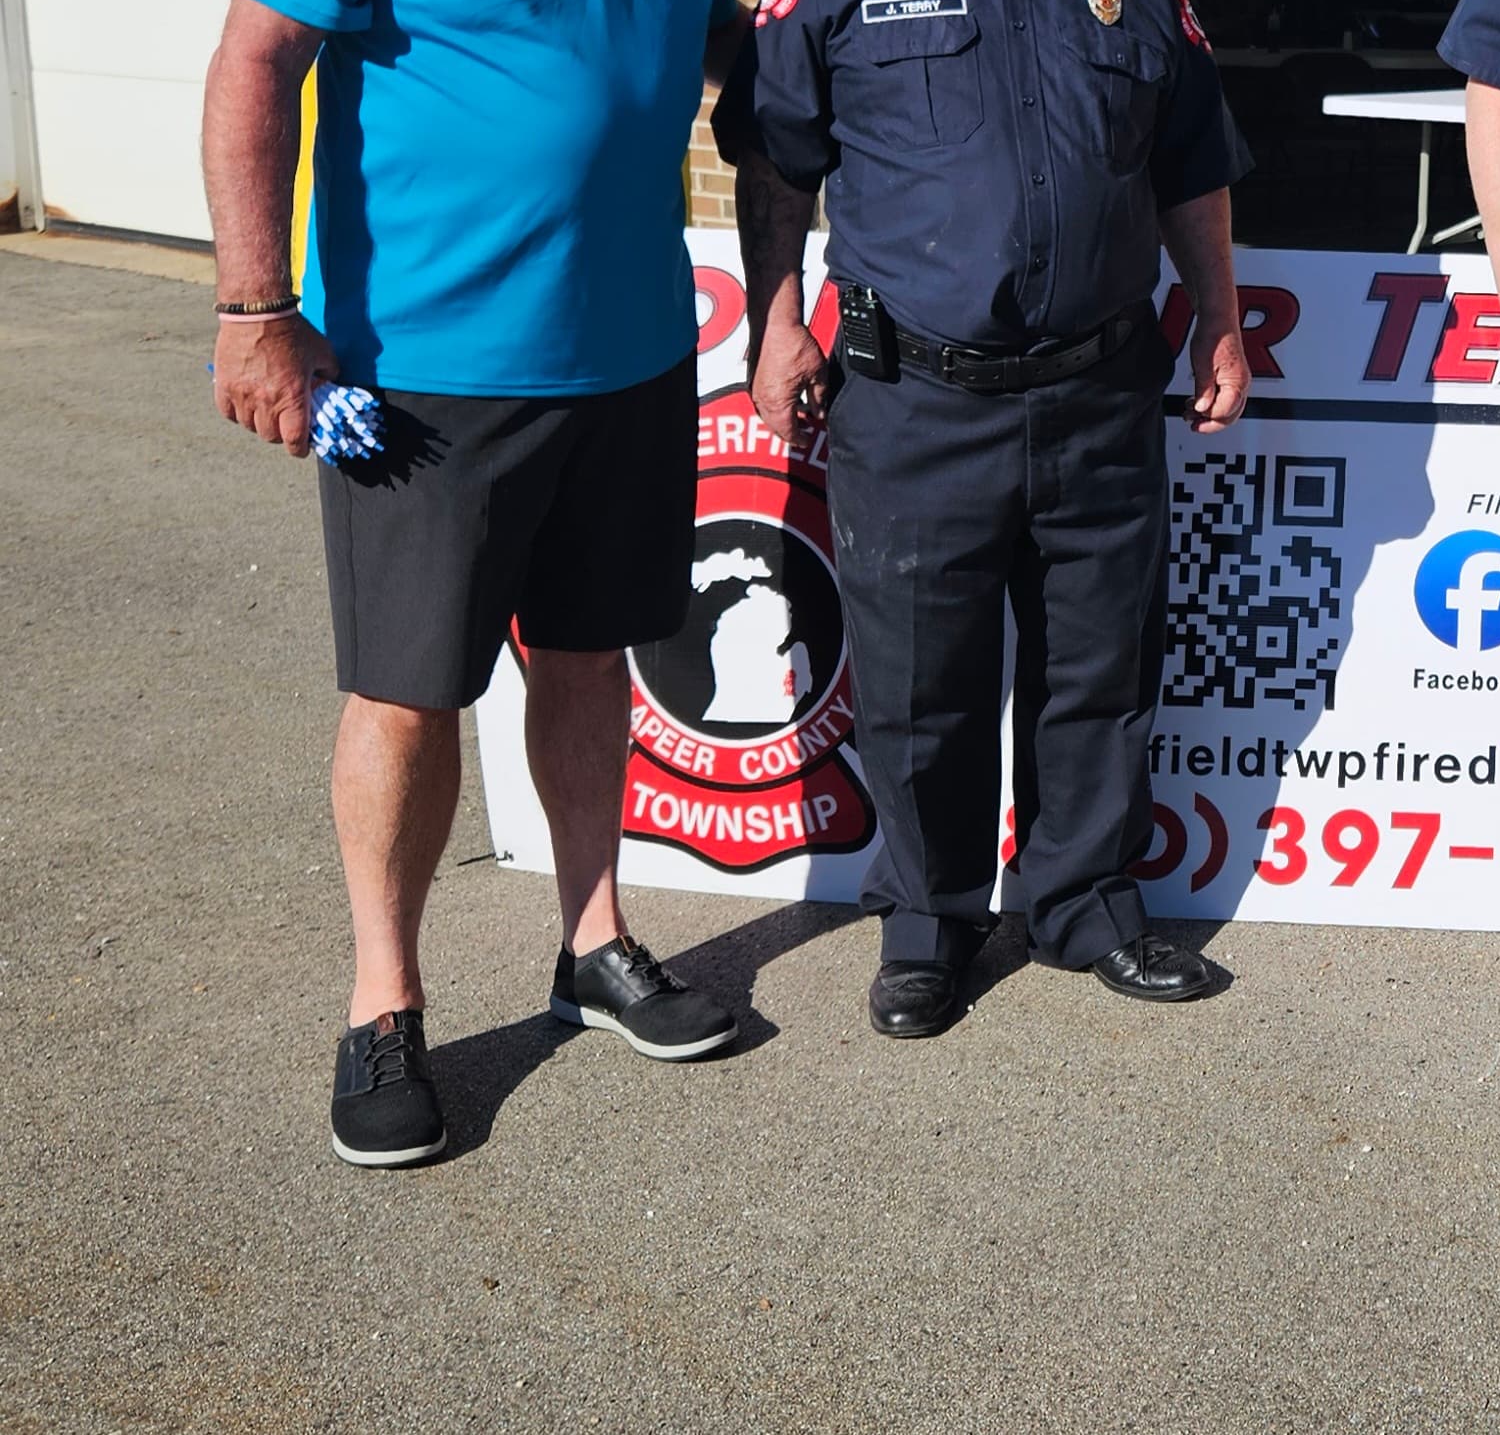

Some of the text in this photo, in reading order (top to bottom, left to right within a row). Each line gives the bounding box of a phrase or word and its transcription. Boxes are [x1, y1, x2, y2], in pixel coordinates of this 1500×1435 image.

[885, 0, 941, 15] J. TERRY
[739, 695, 856, 781] COUNTY
[632, 782, 838, 843] TOWNSHIP
